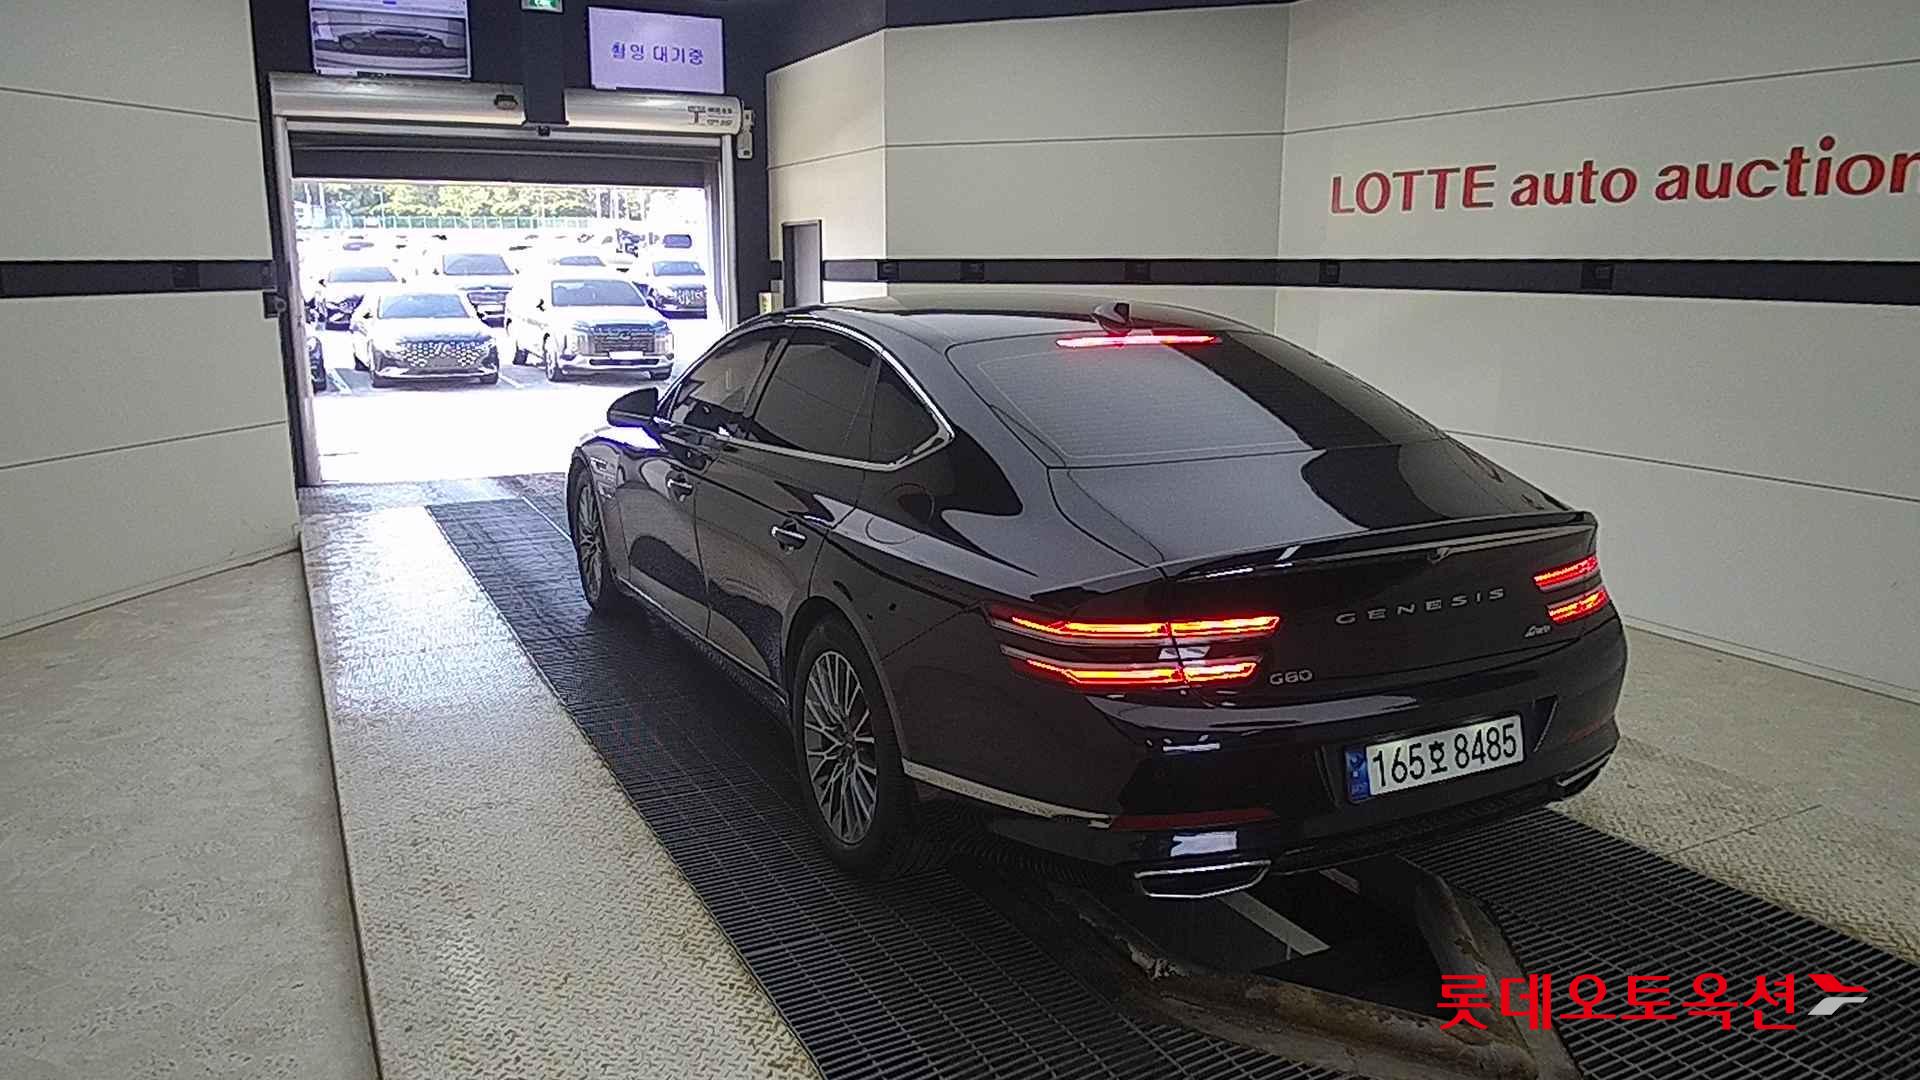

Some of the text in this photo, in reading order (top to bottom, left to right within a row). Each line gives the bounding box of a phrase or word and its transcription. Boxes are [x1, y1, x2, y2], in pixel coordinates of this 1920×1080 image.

[1331, 164, 1497, 214] LOTTE
[1510, 160, 1638, 207] auto
[1335, 588, 1504, 625] GENESIS
[1454, 723, 1517, 769] 8485
